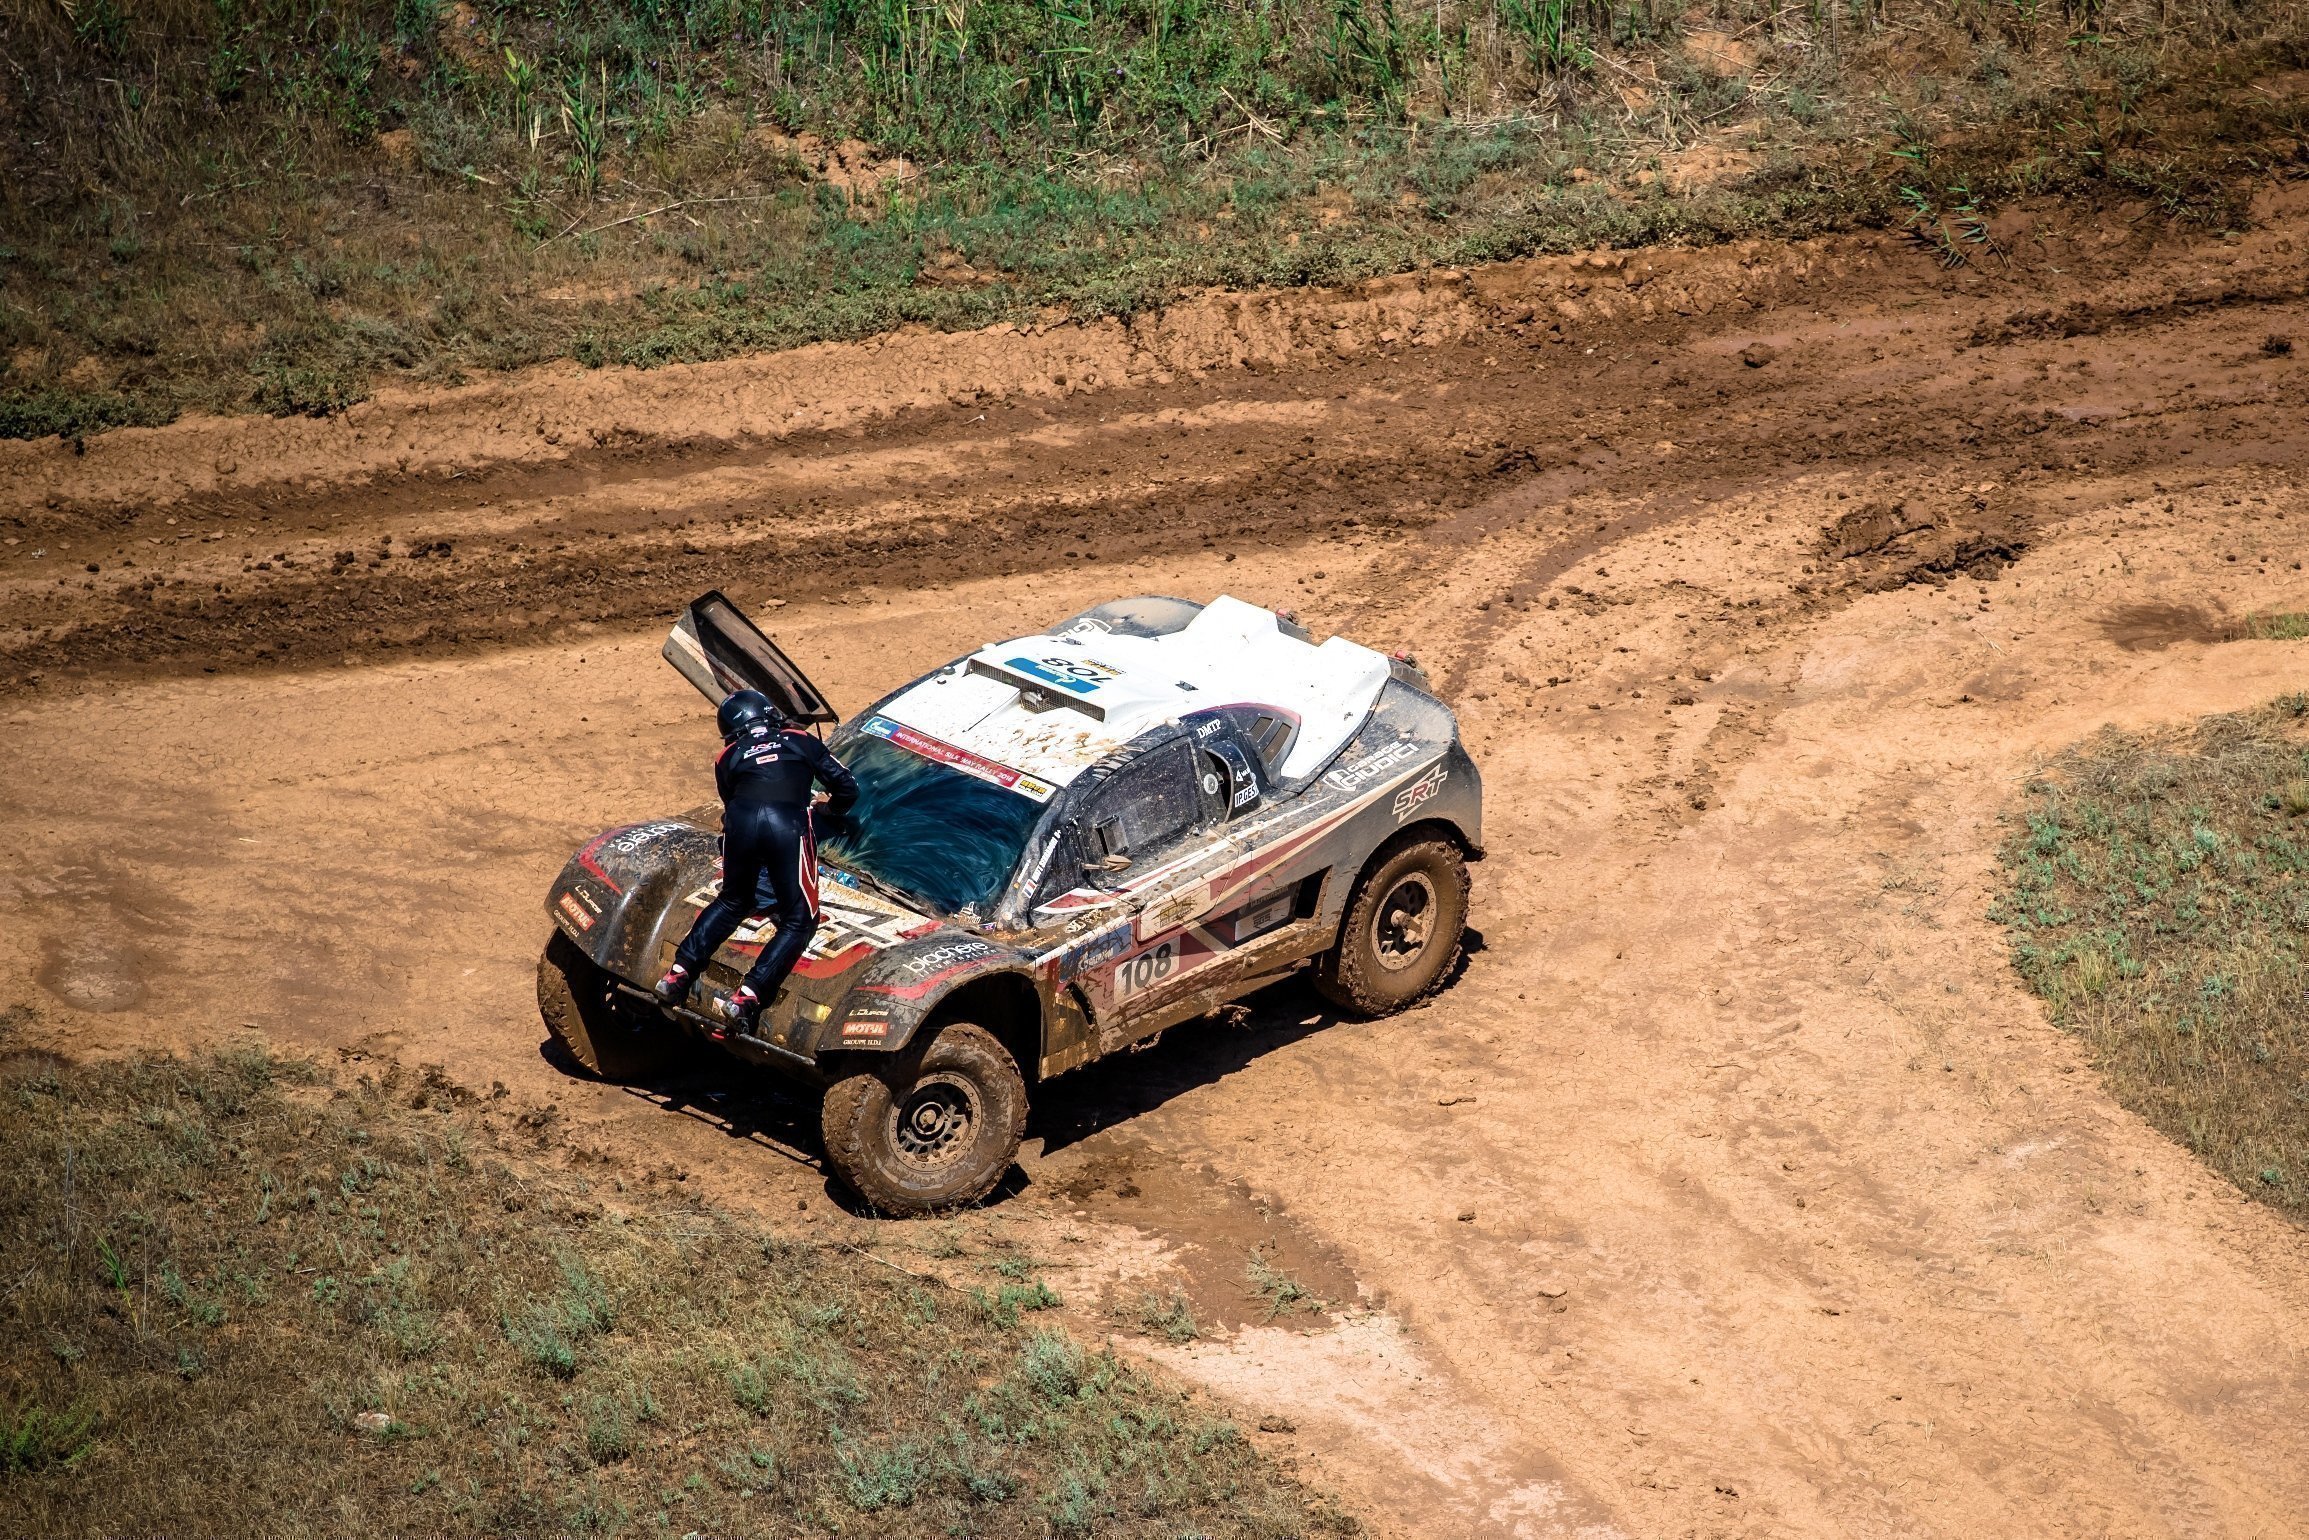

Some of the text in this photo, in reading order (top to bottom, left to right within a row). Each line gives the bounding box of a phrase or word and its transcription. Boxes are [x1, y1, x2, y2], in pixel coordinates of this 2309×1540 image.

[1042, 658, 1112, 683] 108
[1197, 719, 1221, 738] DMTP
[896, 731, 945, 755] INTERNATIONAL
[944, 751, 961, 761] SILK
[975, 762, 999, 776] RALLY
[1340, 742, 1420, 787] GIUDICI
[1392, 766, 1448, 817] SRT
[561, 896, 590, 927] MOTUL
[903, 942, 988, 974] blachere
[1121, 942, 1172, 996] 108
[844, 1023, 885, 1034] MOTUL
